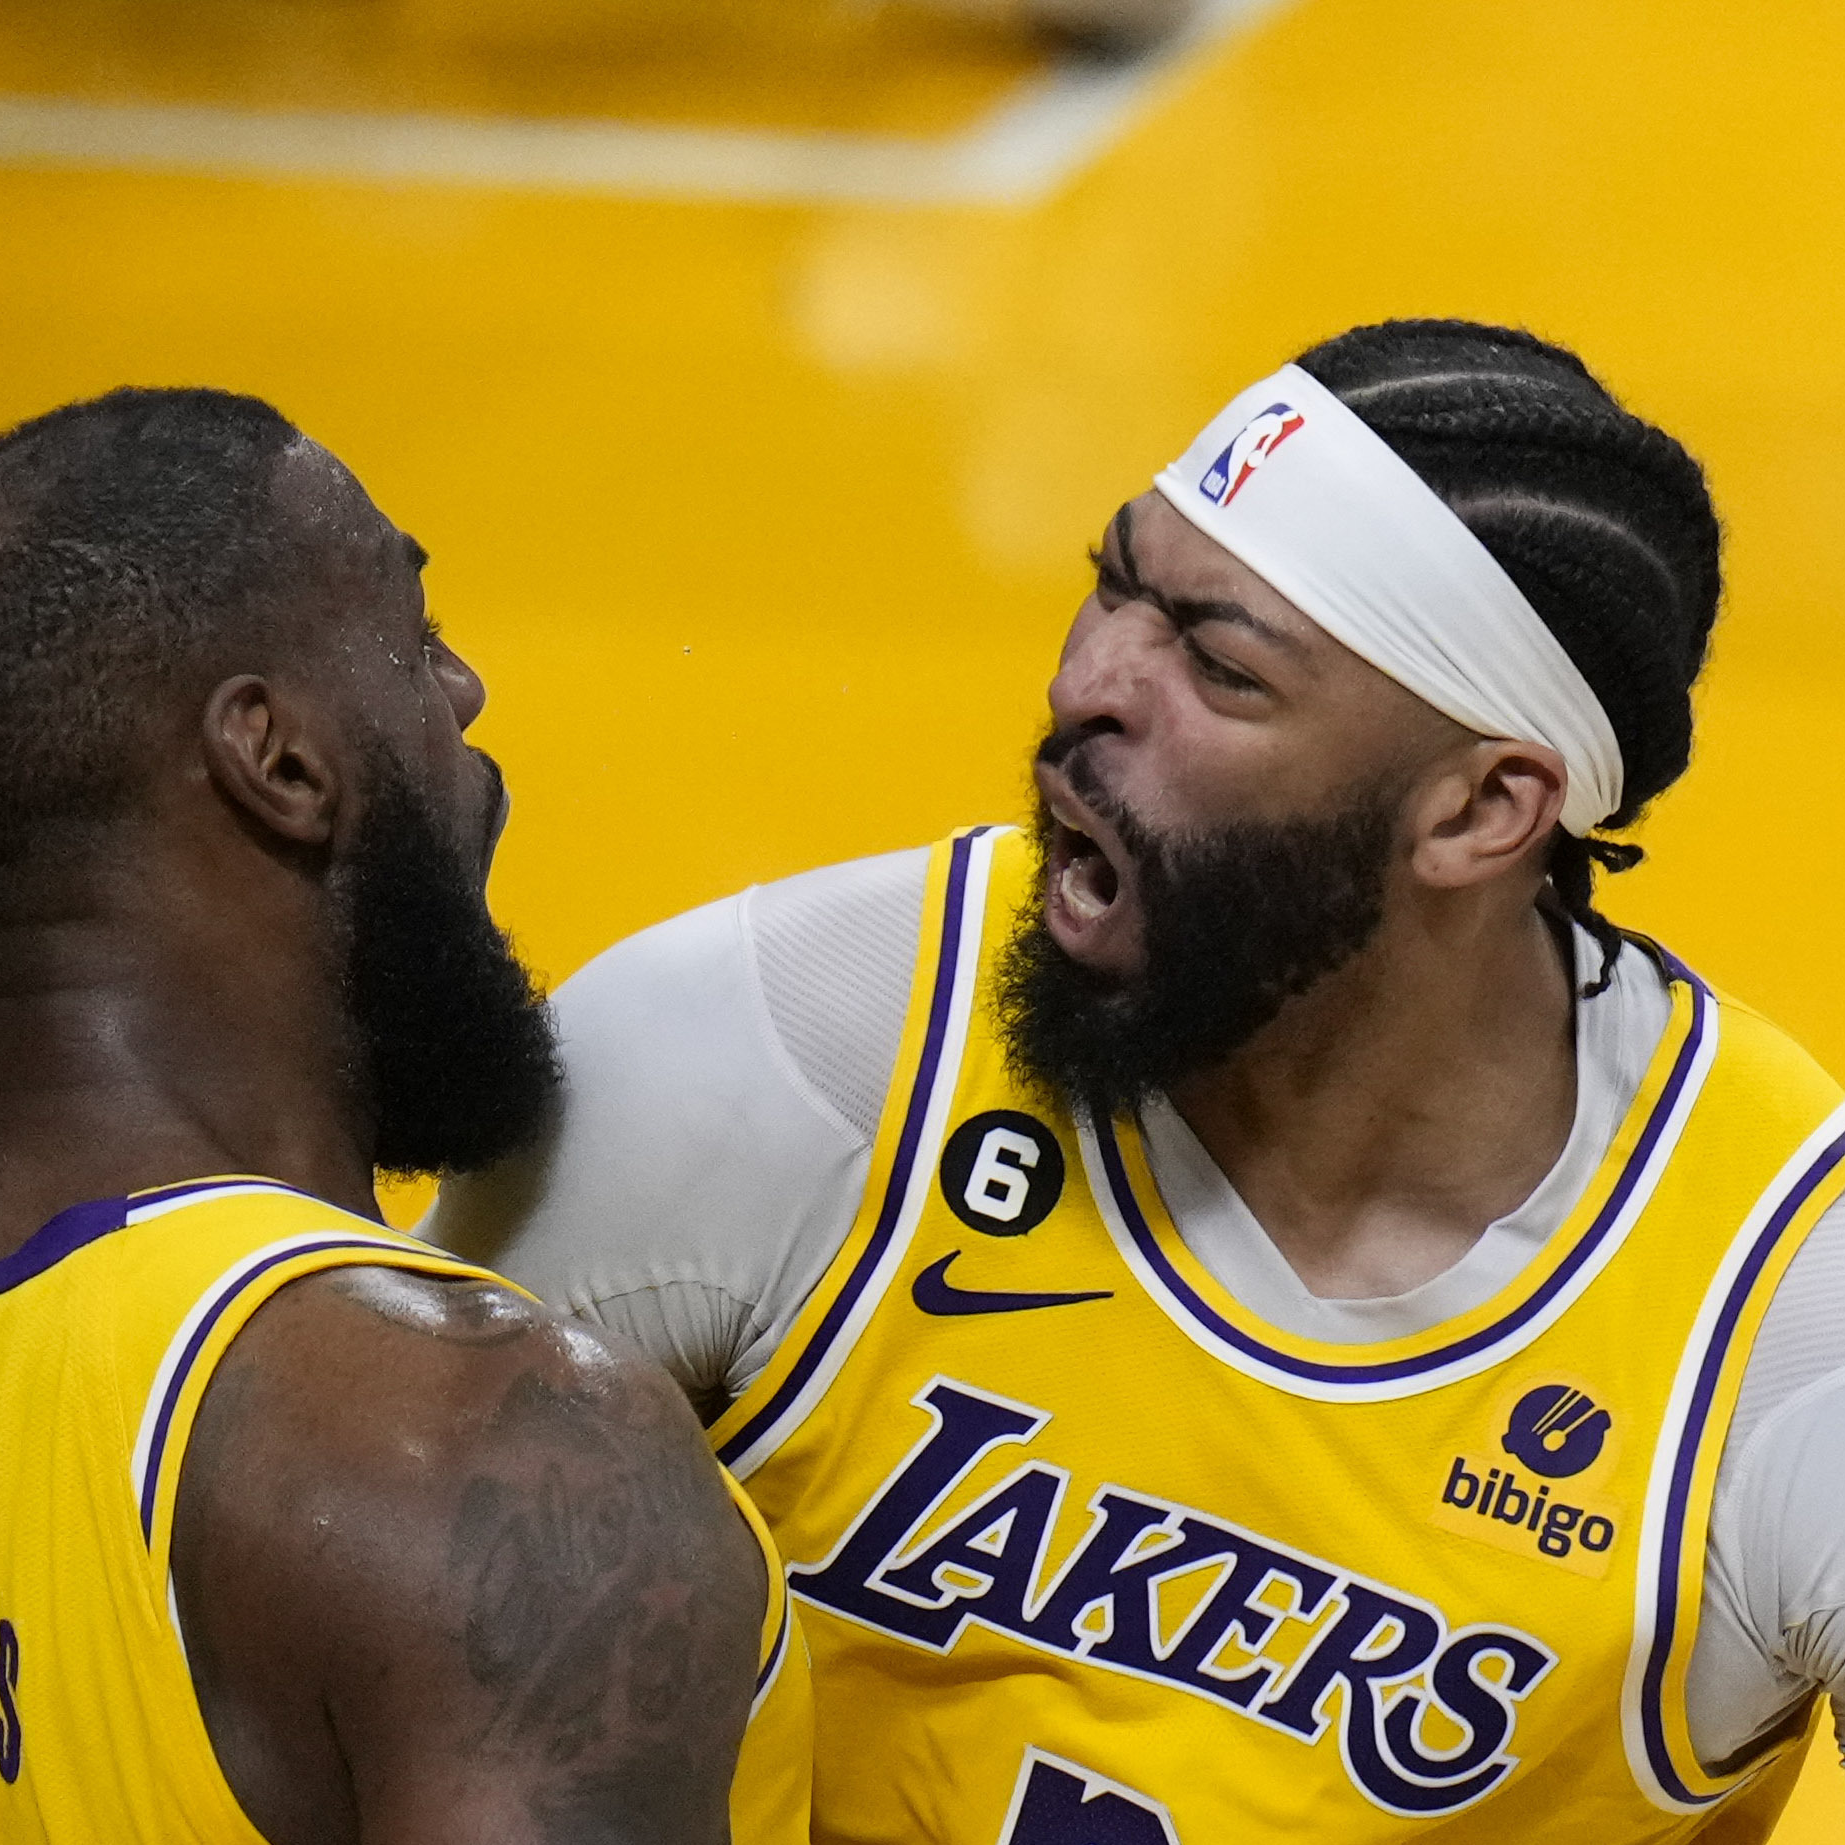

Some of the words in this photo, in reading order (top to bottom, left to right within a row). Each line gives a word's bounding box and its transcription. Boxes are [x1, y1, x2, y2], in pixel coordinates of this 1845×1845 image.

[964, 1127, 1041, 1223] 6
[1442, 1456, 1614, 1558] bibigo
[788, 1375, 1561, 1818] LAKERS
